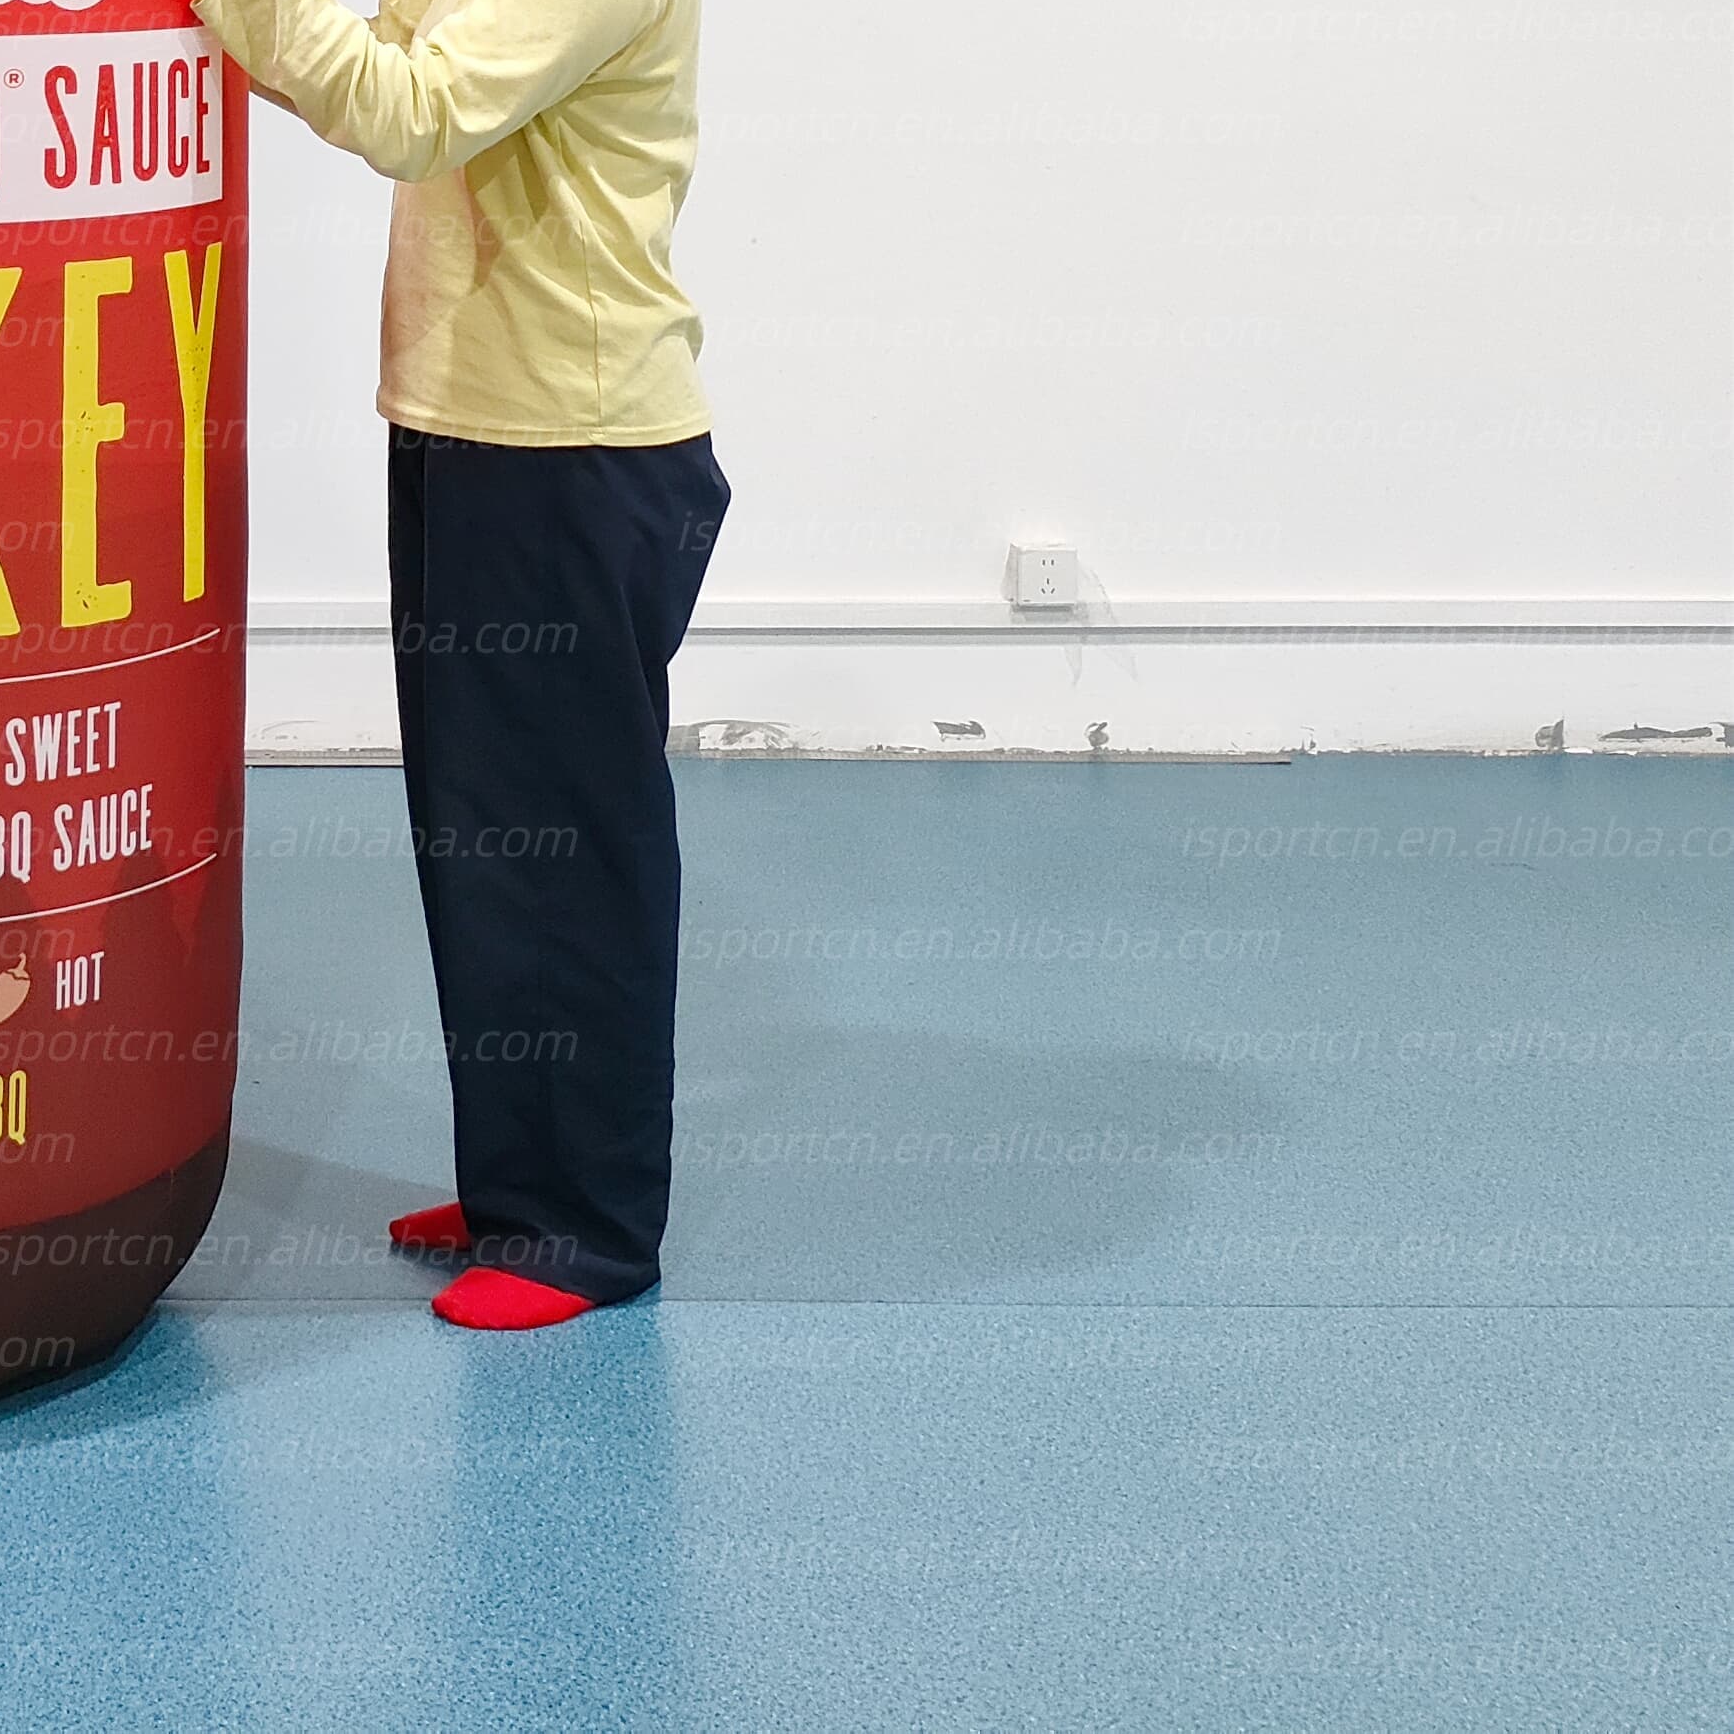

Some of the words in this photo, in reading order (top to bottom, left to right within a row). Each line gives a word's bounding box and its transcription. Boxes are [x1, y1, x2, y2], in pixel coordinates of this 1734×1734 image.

[43, 55, 212, 190] SAUCE
[5, 701, 122, 788] SWEET
[53, 783, 154, 872] SAUCE
[55, 951, 105, 1011] HOT
